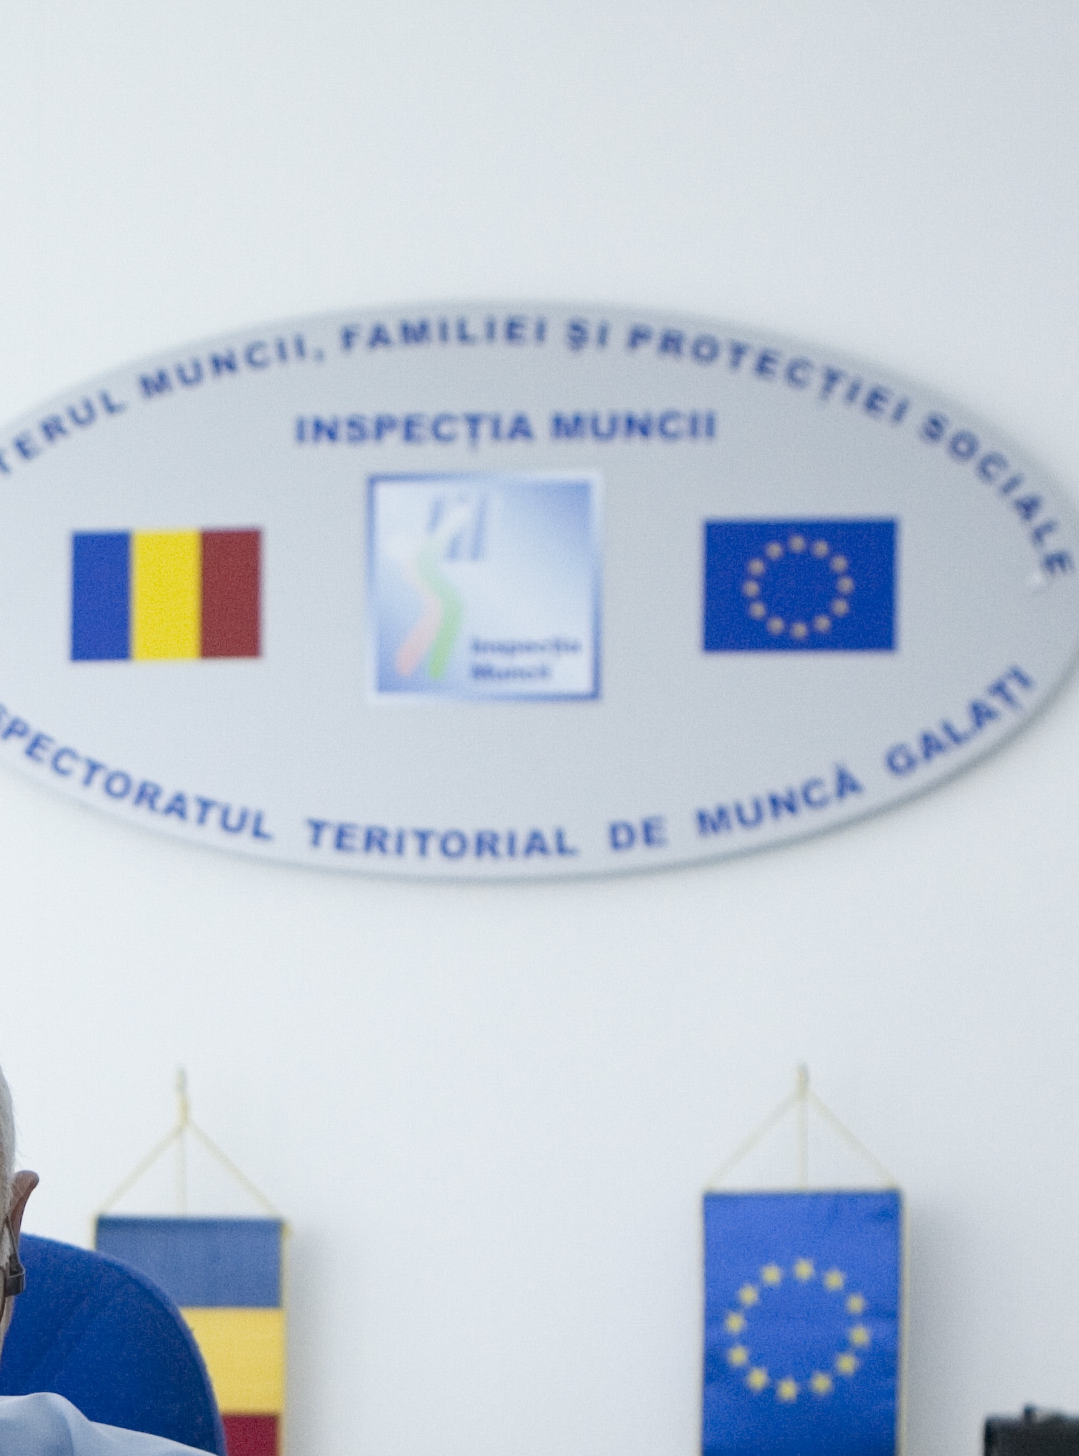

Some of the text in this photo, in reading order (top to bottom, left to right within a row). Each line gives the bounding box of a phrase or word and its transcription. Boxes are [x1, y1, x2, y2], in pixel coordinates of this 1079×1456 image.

[137, 334, 324, 400] MUNCII,
[341, 315, 548, 352] FAMILIEI
[567, 317, 609, 354] ȘI
[627, 322, 912, 424] PROTECȚIEI
[920, 412, 1075, 577] SOCIALE
[294, 410, 717, 452] INSPECȚIA MUNCII
[307, 820, 579, 859] TERITORIAL
[609, 817, 668, 853] DE
[695, 764, 863, 838] MUNCĂ
